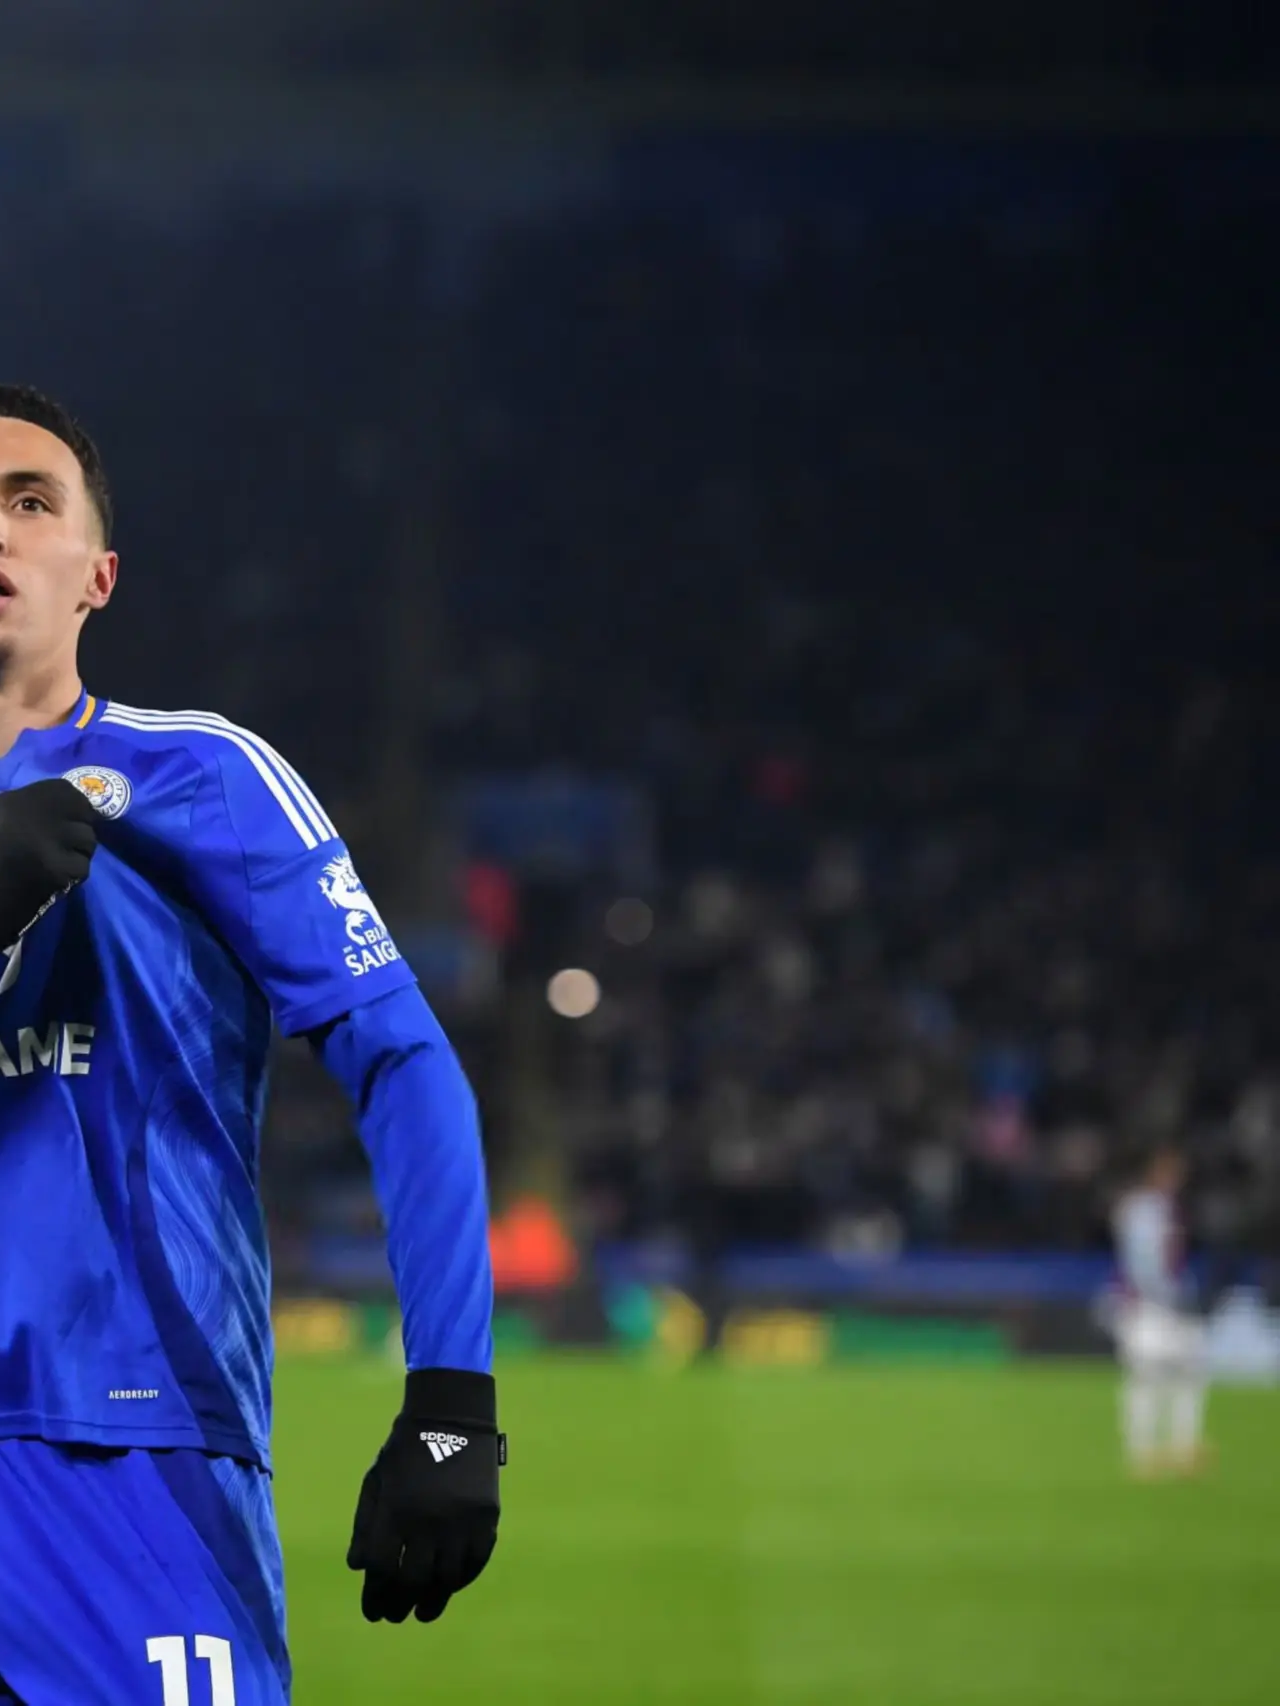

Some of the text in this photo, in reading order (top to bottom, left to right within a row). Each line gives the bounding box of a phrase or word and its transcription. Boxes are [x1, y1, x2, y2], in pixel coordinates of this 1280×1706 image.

[108, 1389, 160, 1400] AEROREADY
[420, 1431, 469, 1447] adidas
[146, 1634, 236, 1706] 11
